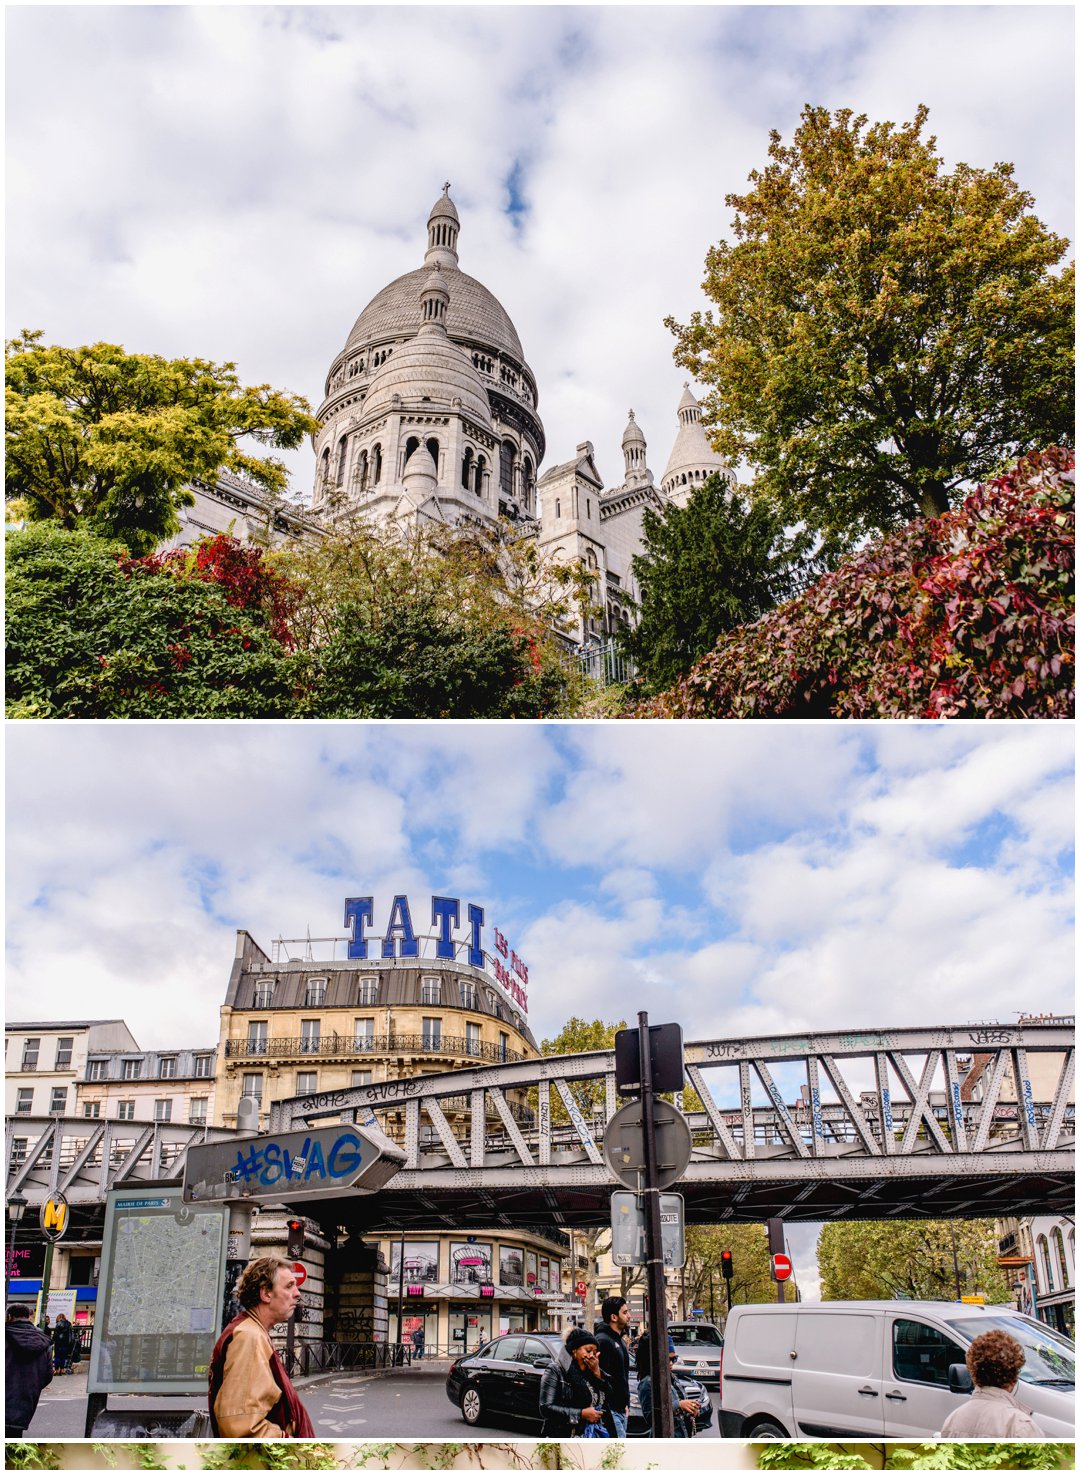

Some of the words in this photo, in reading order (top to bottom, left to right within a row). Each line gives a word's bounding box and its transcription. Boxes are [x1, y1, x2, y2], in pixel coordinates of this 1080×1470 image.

[344, 895, 485, 969] TATI
[231, 1133, 361, 1185] #SWAG
[44, 1200, 66, 1230] M
[181, 1207, 189, 1221] 9
